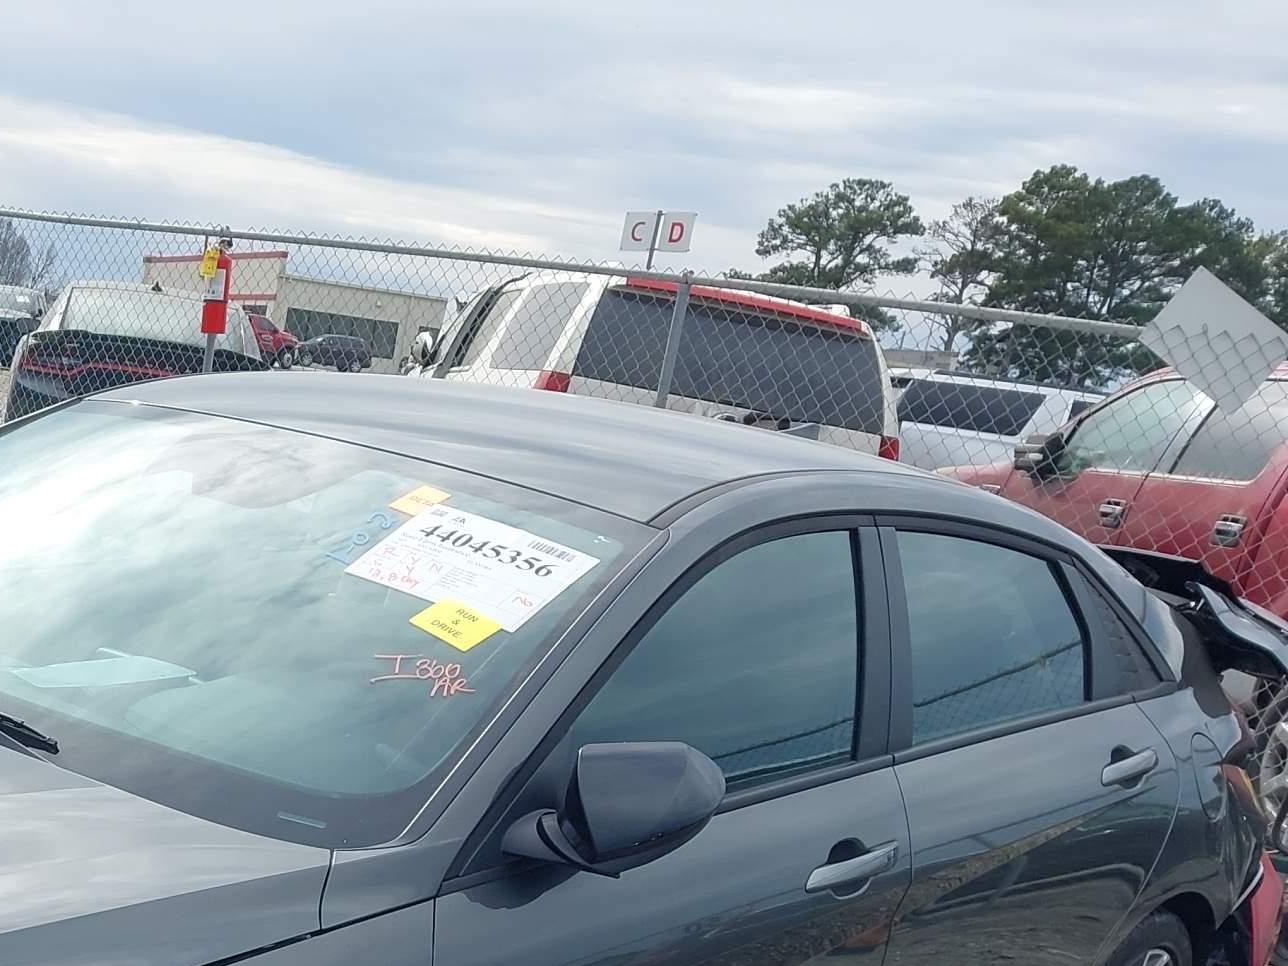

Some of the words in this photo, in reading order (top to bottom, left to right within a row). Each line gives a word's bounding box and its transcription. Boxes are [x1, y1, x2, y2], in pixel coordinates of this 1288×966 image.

[631, 221, 646, 242] C
[668, 221, 685, 243] D
[419, 523, 561, 579] 44045356
[455, 608, 479, 623] RUN
[430, 619, 463, 638] DRIVE
